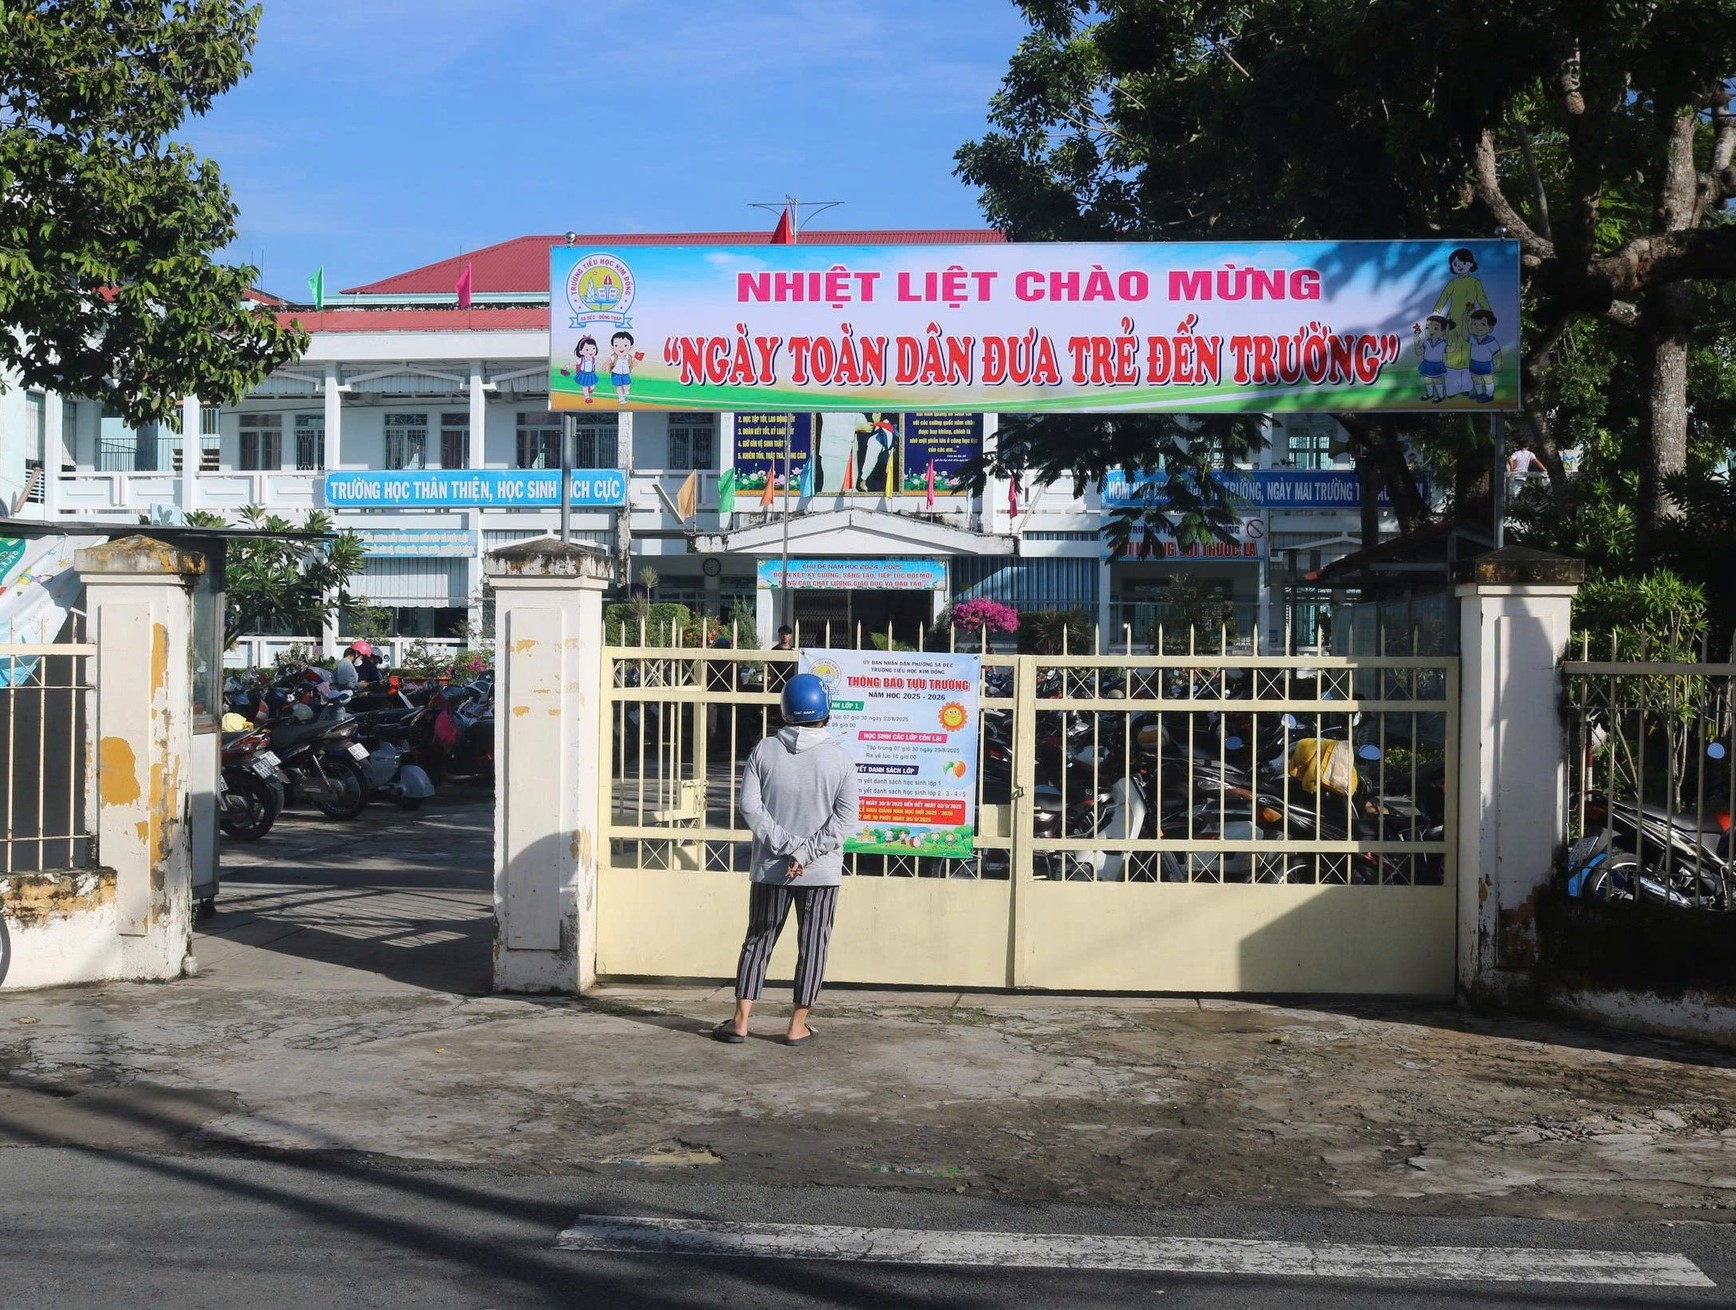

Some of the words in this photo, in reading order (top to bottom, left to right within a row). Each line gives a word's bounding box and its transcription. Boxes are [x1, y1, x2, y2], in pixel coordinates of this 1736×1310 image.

[738, 266, 880, 308] NHIỆT
[898, 266, 998, 308] LIỆT
[1015, 264, 1148, 301] CHÀO
[1168, 264, 1320, 301] MỪNG
[788, 323, 888, 386] TOÀN
[894, 322, 976, 386] DÂN
[982, 327, 1060, 386] ĐƯA
[1068, 316, 1139, 386] TRẺ
[1147, 314, 1224, 386] ĐẾN
[331, 477, 380, 500] TRƯỜNG
[384, 481, 410, 502] HỌC
[413, 476, 448, 499] THÂN
[452, 476, 493, 502] THIỆN,
[498, 480, 524, 502] HỌC
[528, 480, 556, 499] SINH
[562, 476, 590, 498] ÍCH
[594, 477, 620, 502] CỰC
[1267, 477, 1291, 500] NGÀY
[1295, 482, 1312, 500] MAI
[1314, 477, 1352, 500] TRƯỜNG
[847, 675, 881, 688] THÔNG
[883, 676, 904, 690] BÁO
[929, 678, 970, 692] TRƯỜNG
